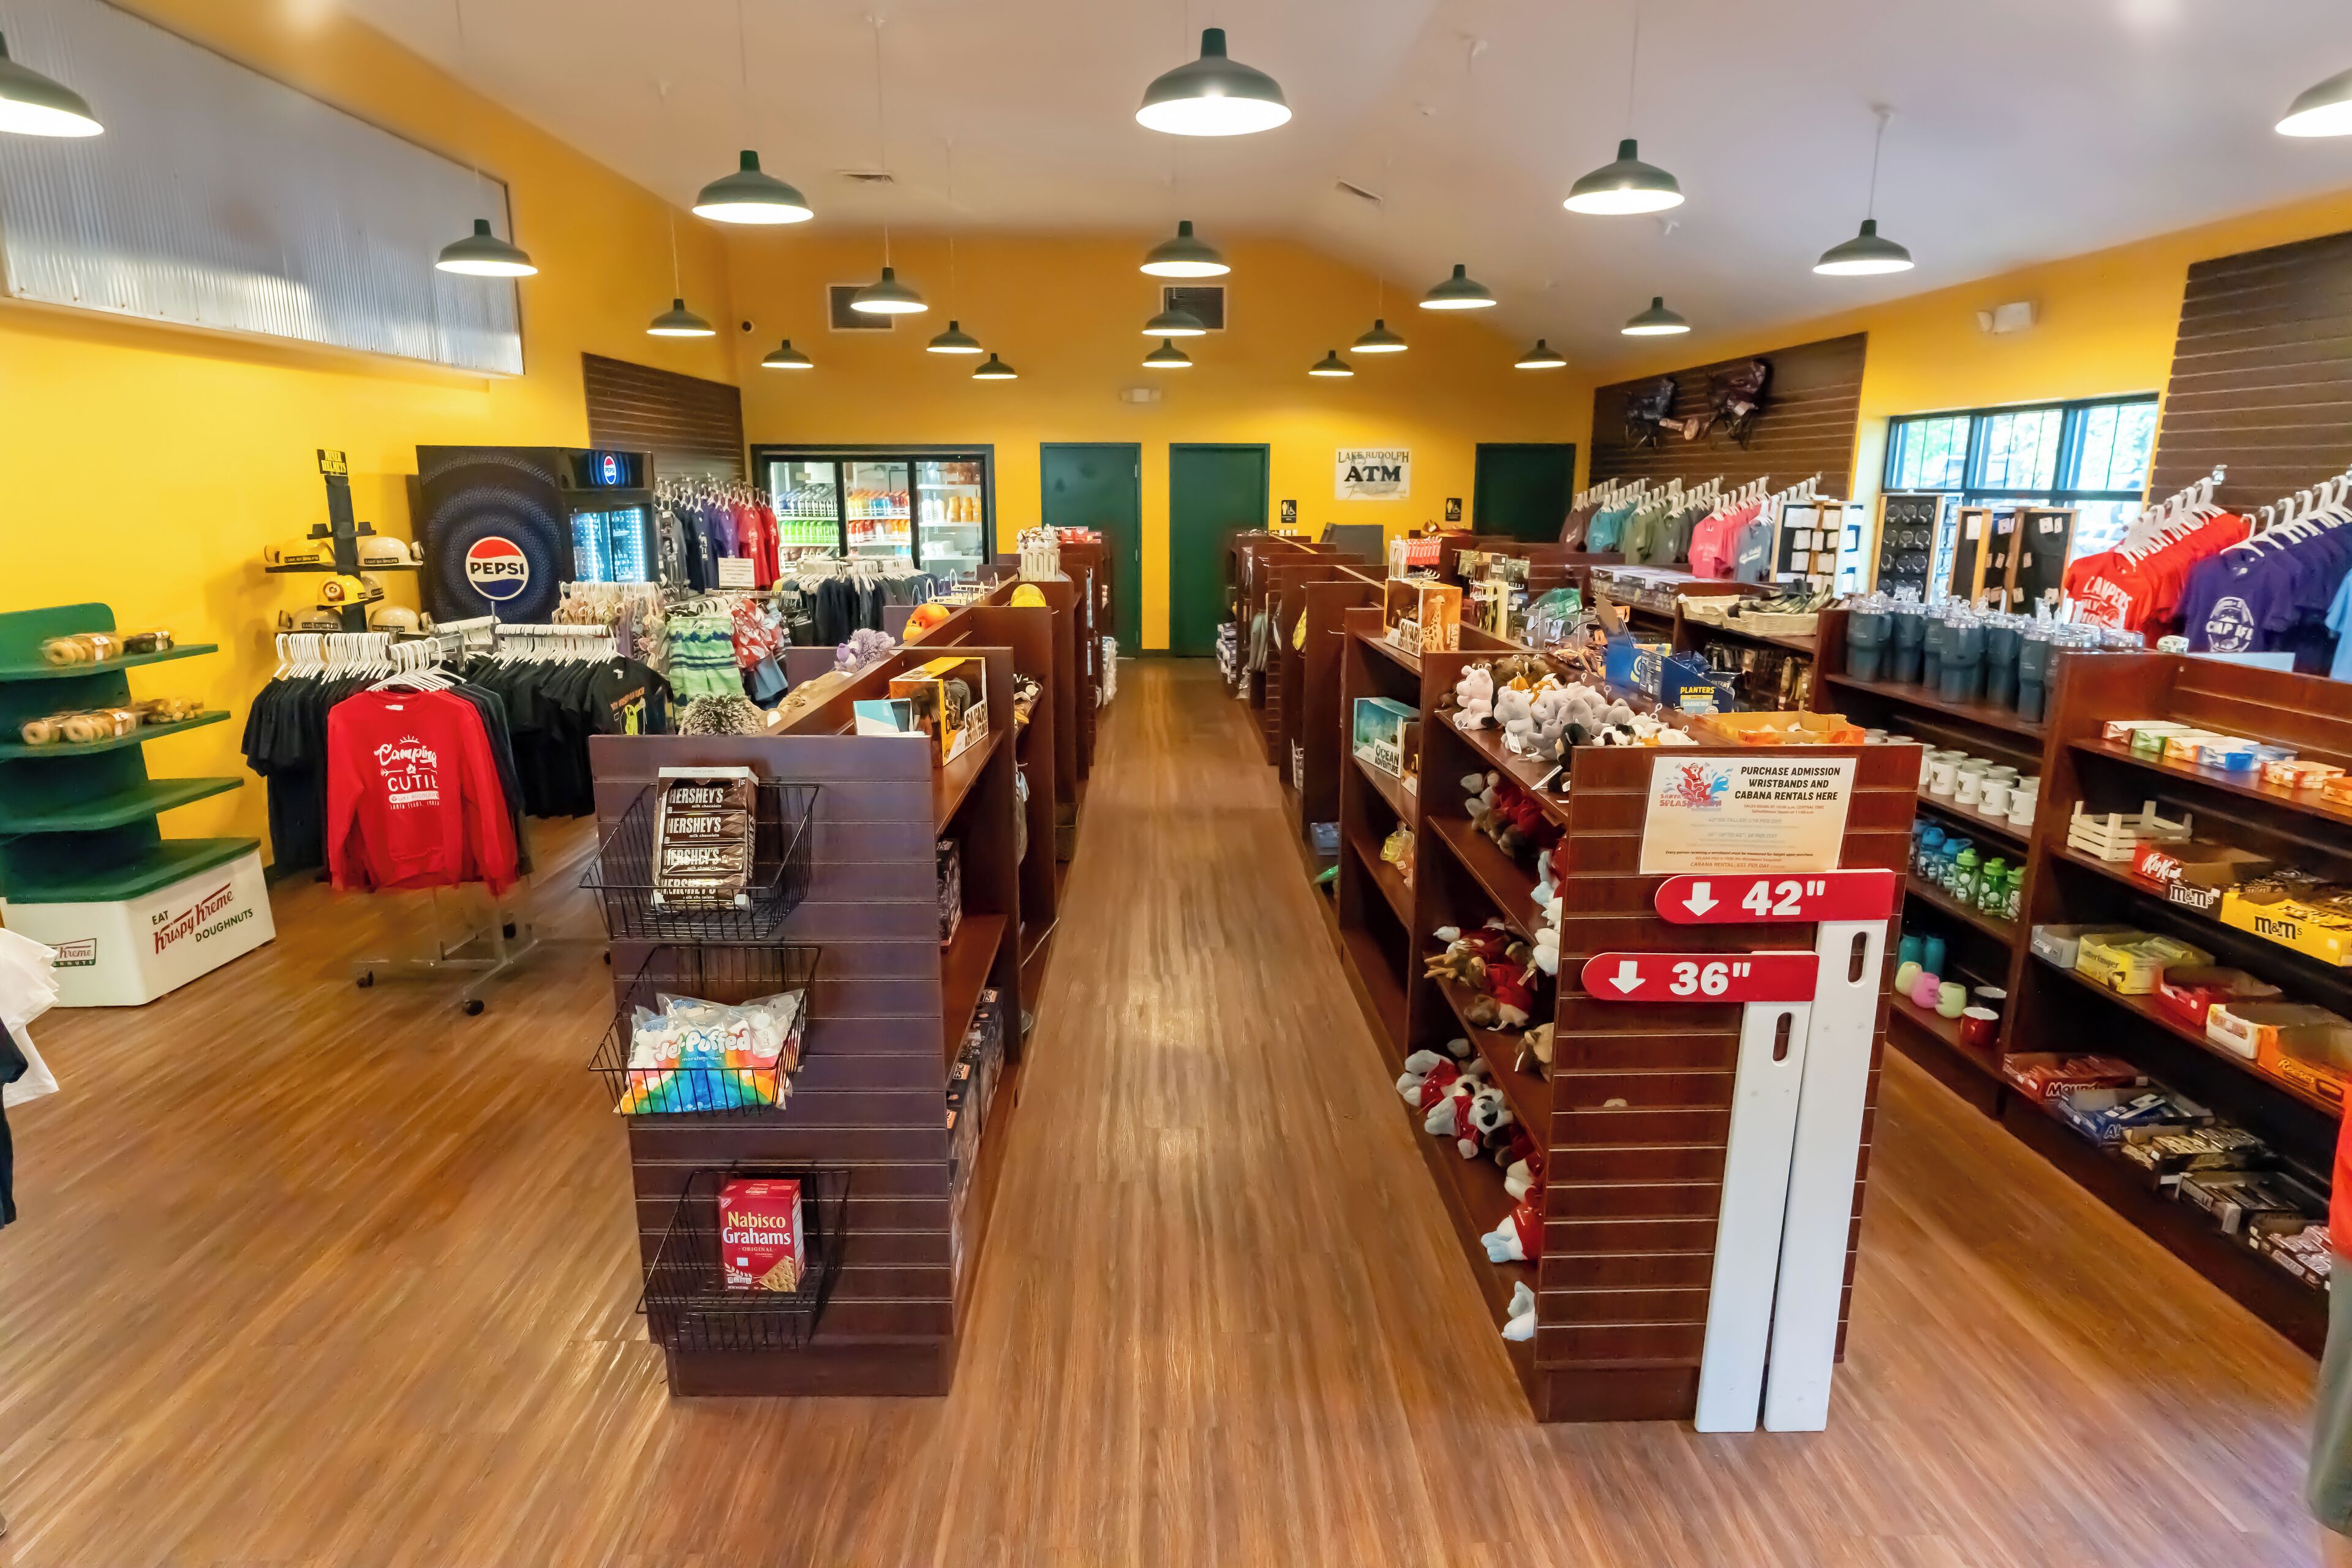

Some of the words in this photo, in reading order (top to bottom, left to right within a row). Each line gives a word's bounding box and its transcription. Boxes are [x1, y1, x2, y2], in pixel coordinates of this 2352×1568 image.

[1338, 451, 1363, 463] LAKE
[1366, 451, 1409, 463] RUDOLPH
[1344, 466, 1401, 482] ATM
[470, 562, 524, 575] PEPSI
[966, 703, 987, 731] SAFARI
[374, 744, 437, 768] Camping
[1376, 744, 1400, 766] OCEAN
[1375, 756, 1398, 775] ADVENTURE
[1741, 767, 1789, 775] PURCHASE
[1791, 767, 1841, 776] ADMISSION
[1749, 779, 1808, 788] WRISTBANDS
[669, 788, 723, 804] HERSHEY'S
[1735, 791, 1771, 800] CABANA
[666, 817, 721, 834] HERSHEY'S
[664, 849, 720, 865] HERSHEY'S
[1742, 880, 1826, 916] 42"
[152, 910, 169, 925] EAT
[153, 908, 195, 955] Krispy
[195, 882, 234, 925] Kreme
[195, 908, 253, 943] DOUGHNUTS
[60, 945, 92, 959] Kreme
[1669, 962, 1751, 996] 36"
[655, 1029, 751, 1061] Jet-Puffed
[954, 1063, 964, 1080] EPIC
[728, 1212, 786, 1228] Nabisco
[723, 1227, 791, 1245] Grahams
